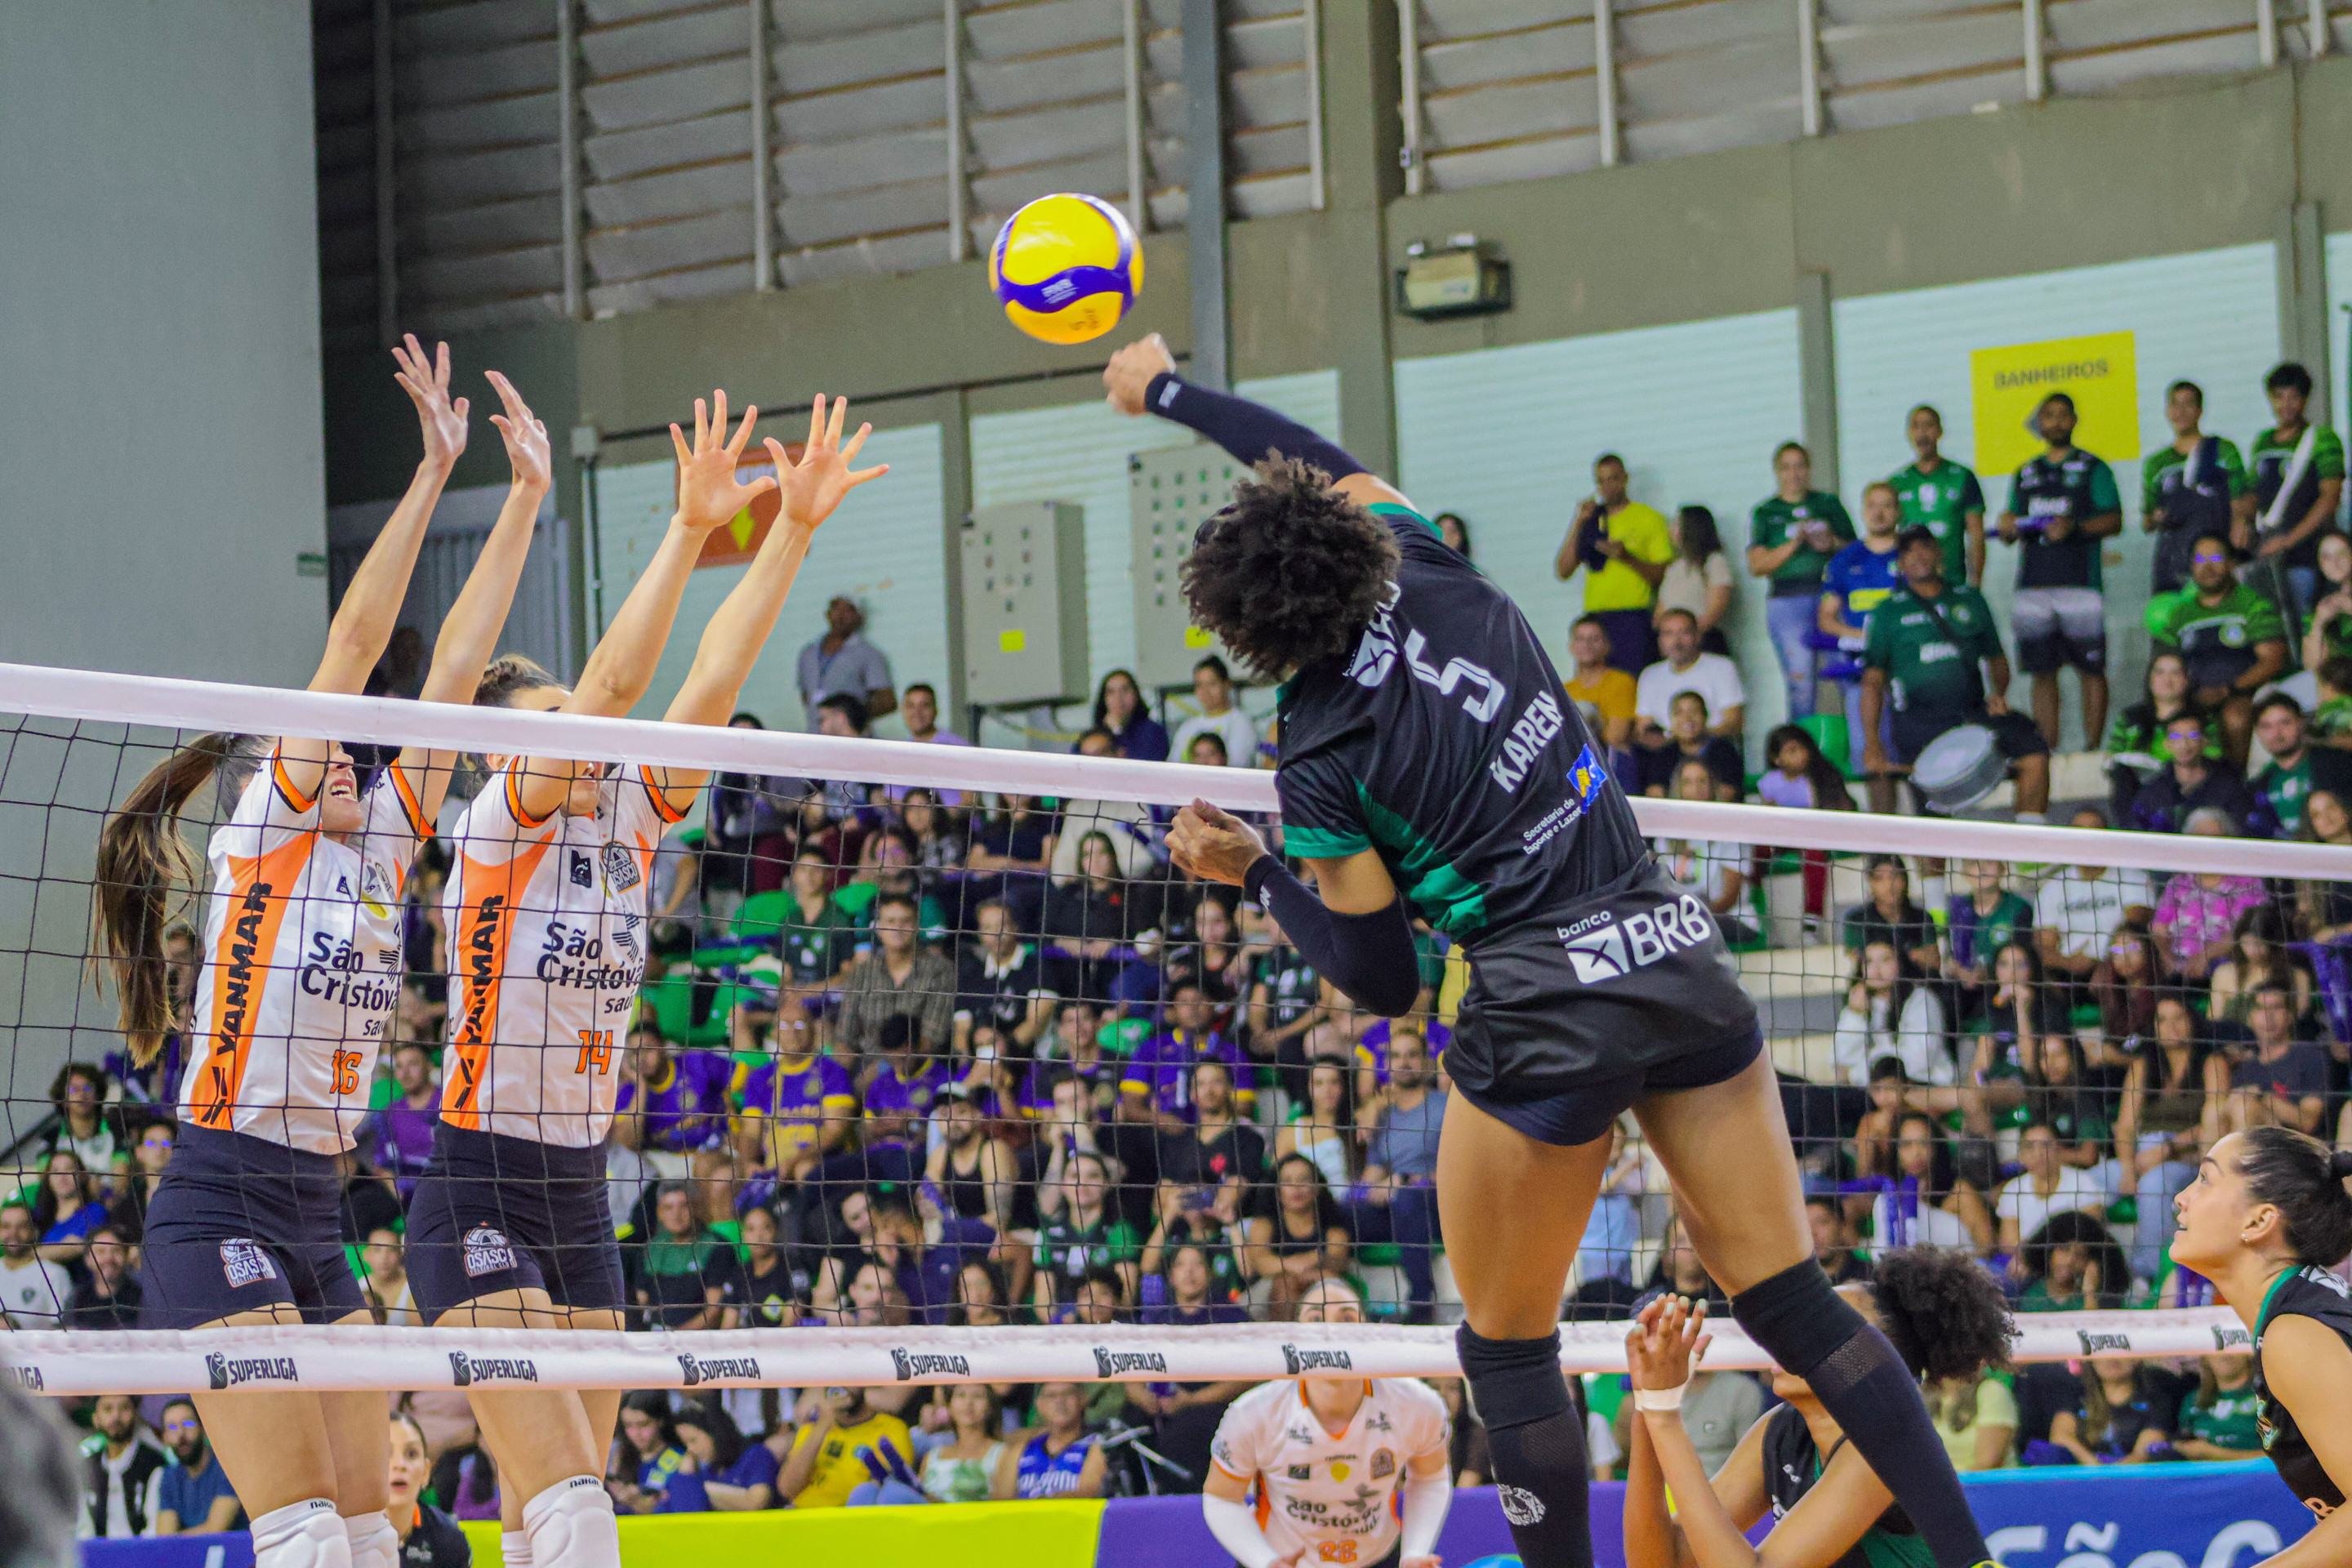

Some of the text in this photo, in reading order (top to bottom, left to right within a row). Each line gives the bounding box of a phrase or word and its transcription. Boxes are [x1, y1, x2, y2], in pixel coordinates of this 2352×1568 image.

[1993, 358, 2109, 390] BANHEIROS
[1404, 628, 1506, 723] 5
[1490, 689, 1564, 794] KAREN
[1522, 806, 1582, 855] Esporte e Lazer
[1523, 798, 1575, 841] Secretaria de
[542, 922, 602, 960] São
[1557, 911, 1611, 939] banco
[1622, 894, 1710, 967] BRB
[216, 882, 273, 1056] YANMAR
[308, 931, 363, 974] São
[329, 1049, 363, 1094] 16
[575, 1030, 613, 1075] 14
[1298, 1350, 1352, 1371] SUPERLIGA
[2090, 1334, 2131, 1352] SUPERLIGA
[228, 1356, 298, 1385] SUPERLIGA
[471, 1356, 538, 1383] SUPERLIGA
[702, 1356, 761, 1382] SUPERLIGA
[911, 1354, 970, 1377] SUPERLIGA
[1111, 1352, 1167, 1374] SUPERLIGA
